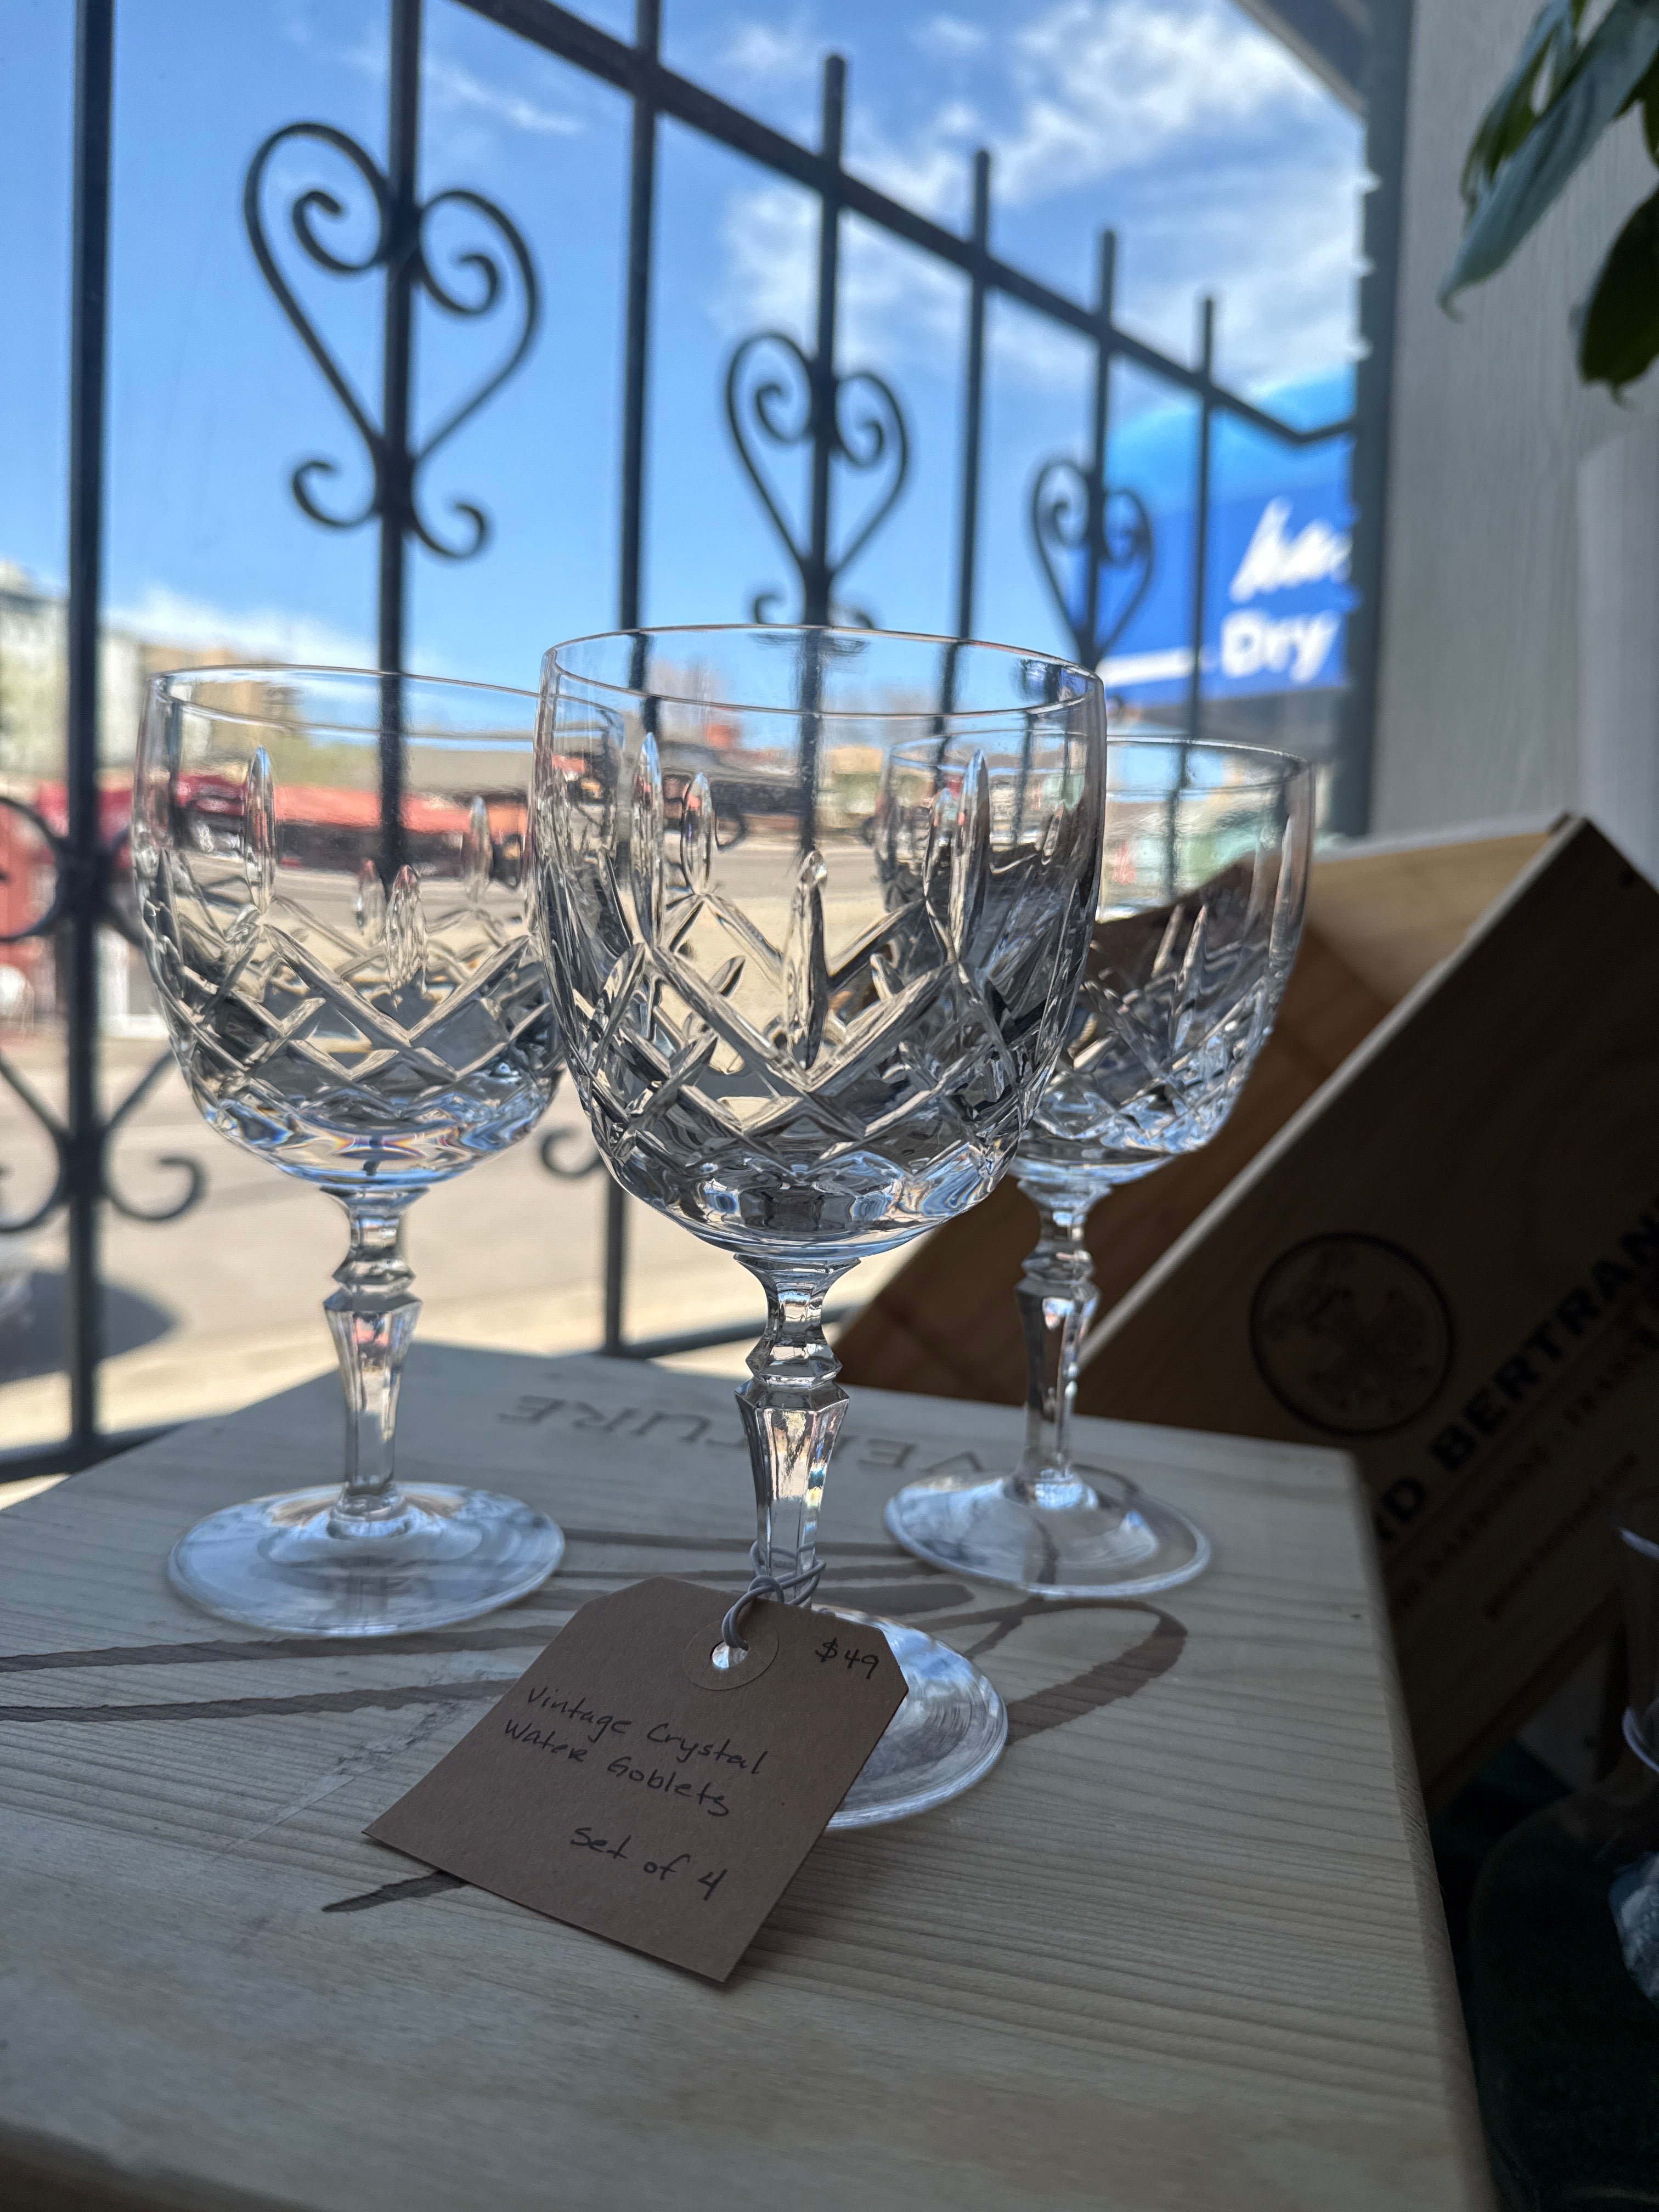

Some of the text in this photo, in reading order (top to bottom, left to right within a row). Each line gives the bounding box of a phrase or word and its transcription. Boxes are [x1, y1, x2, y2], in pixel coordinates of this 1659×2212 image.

[1431, 1199, 1659, 1470] BERTRAN
[815, 1637, 879, 1679] $49
[528, 1687, 768, 1774] Vintage Crystal
[607, 1756, 729, 1817] Goblets
[570, 1827, 728, 1901] Set of 4
